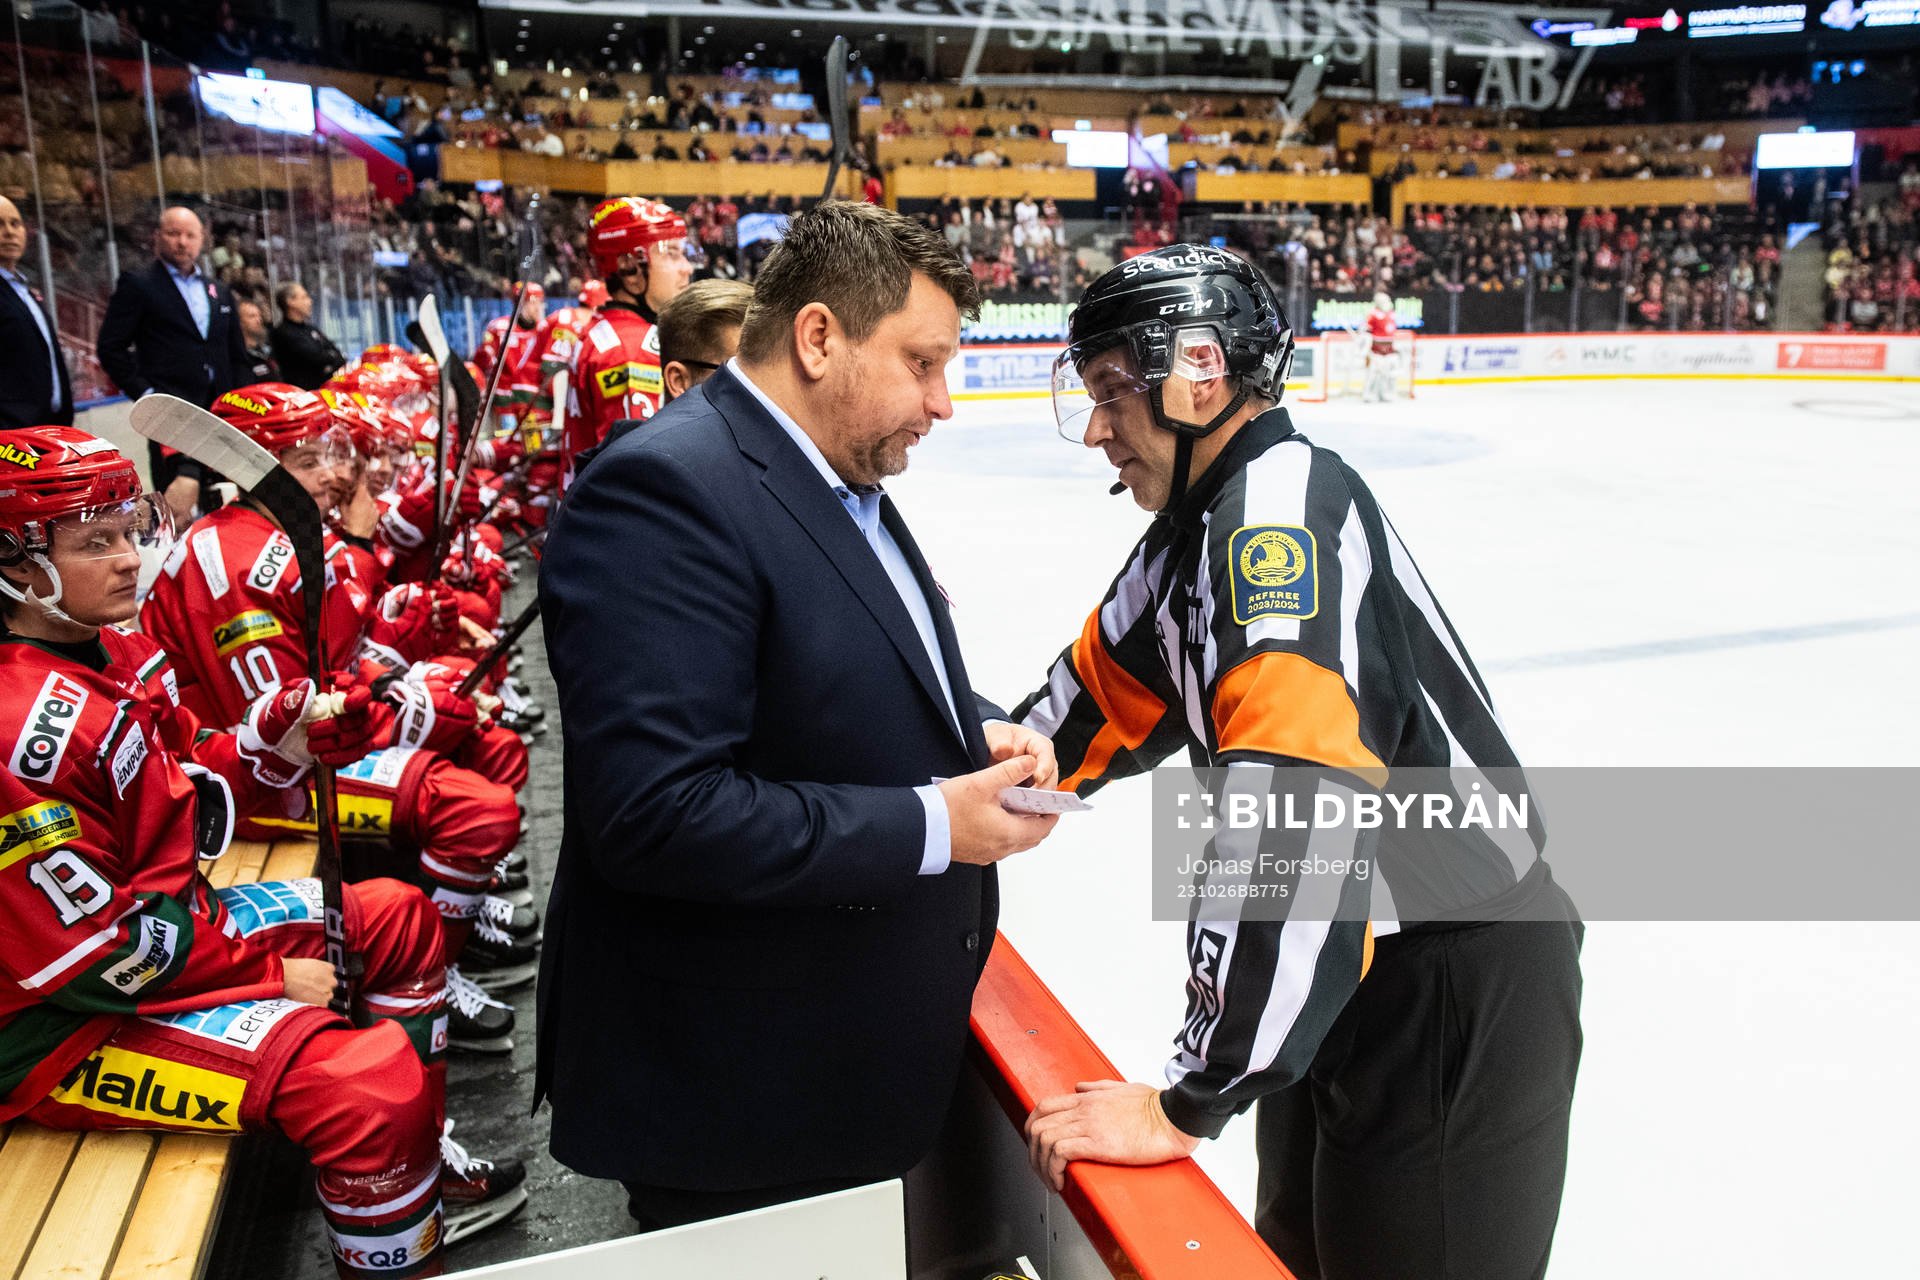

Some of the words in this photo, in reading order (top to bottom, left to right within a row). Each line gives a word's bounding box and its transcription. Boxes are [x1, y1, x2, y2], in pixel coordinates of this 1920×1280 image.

[1123, 247, 1222, 279] Scandic
[1159, 299, 1214, 316] CCM
[1145, 372, 1169, 381] CCM
[221, 392, 268, 417] Malux
[1247, 599, 1301, 614] 2023/2024
[1248, 591, 1300, 604] REFEREE
[230, 645, 282, 701] 10
[19, 677, 82, 778] coreIT
[29, 849, 112, 926] 19
[59, 1056, 231, 1126] Malux
